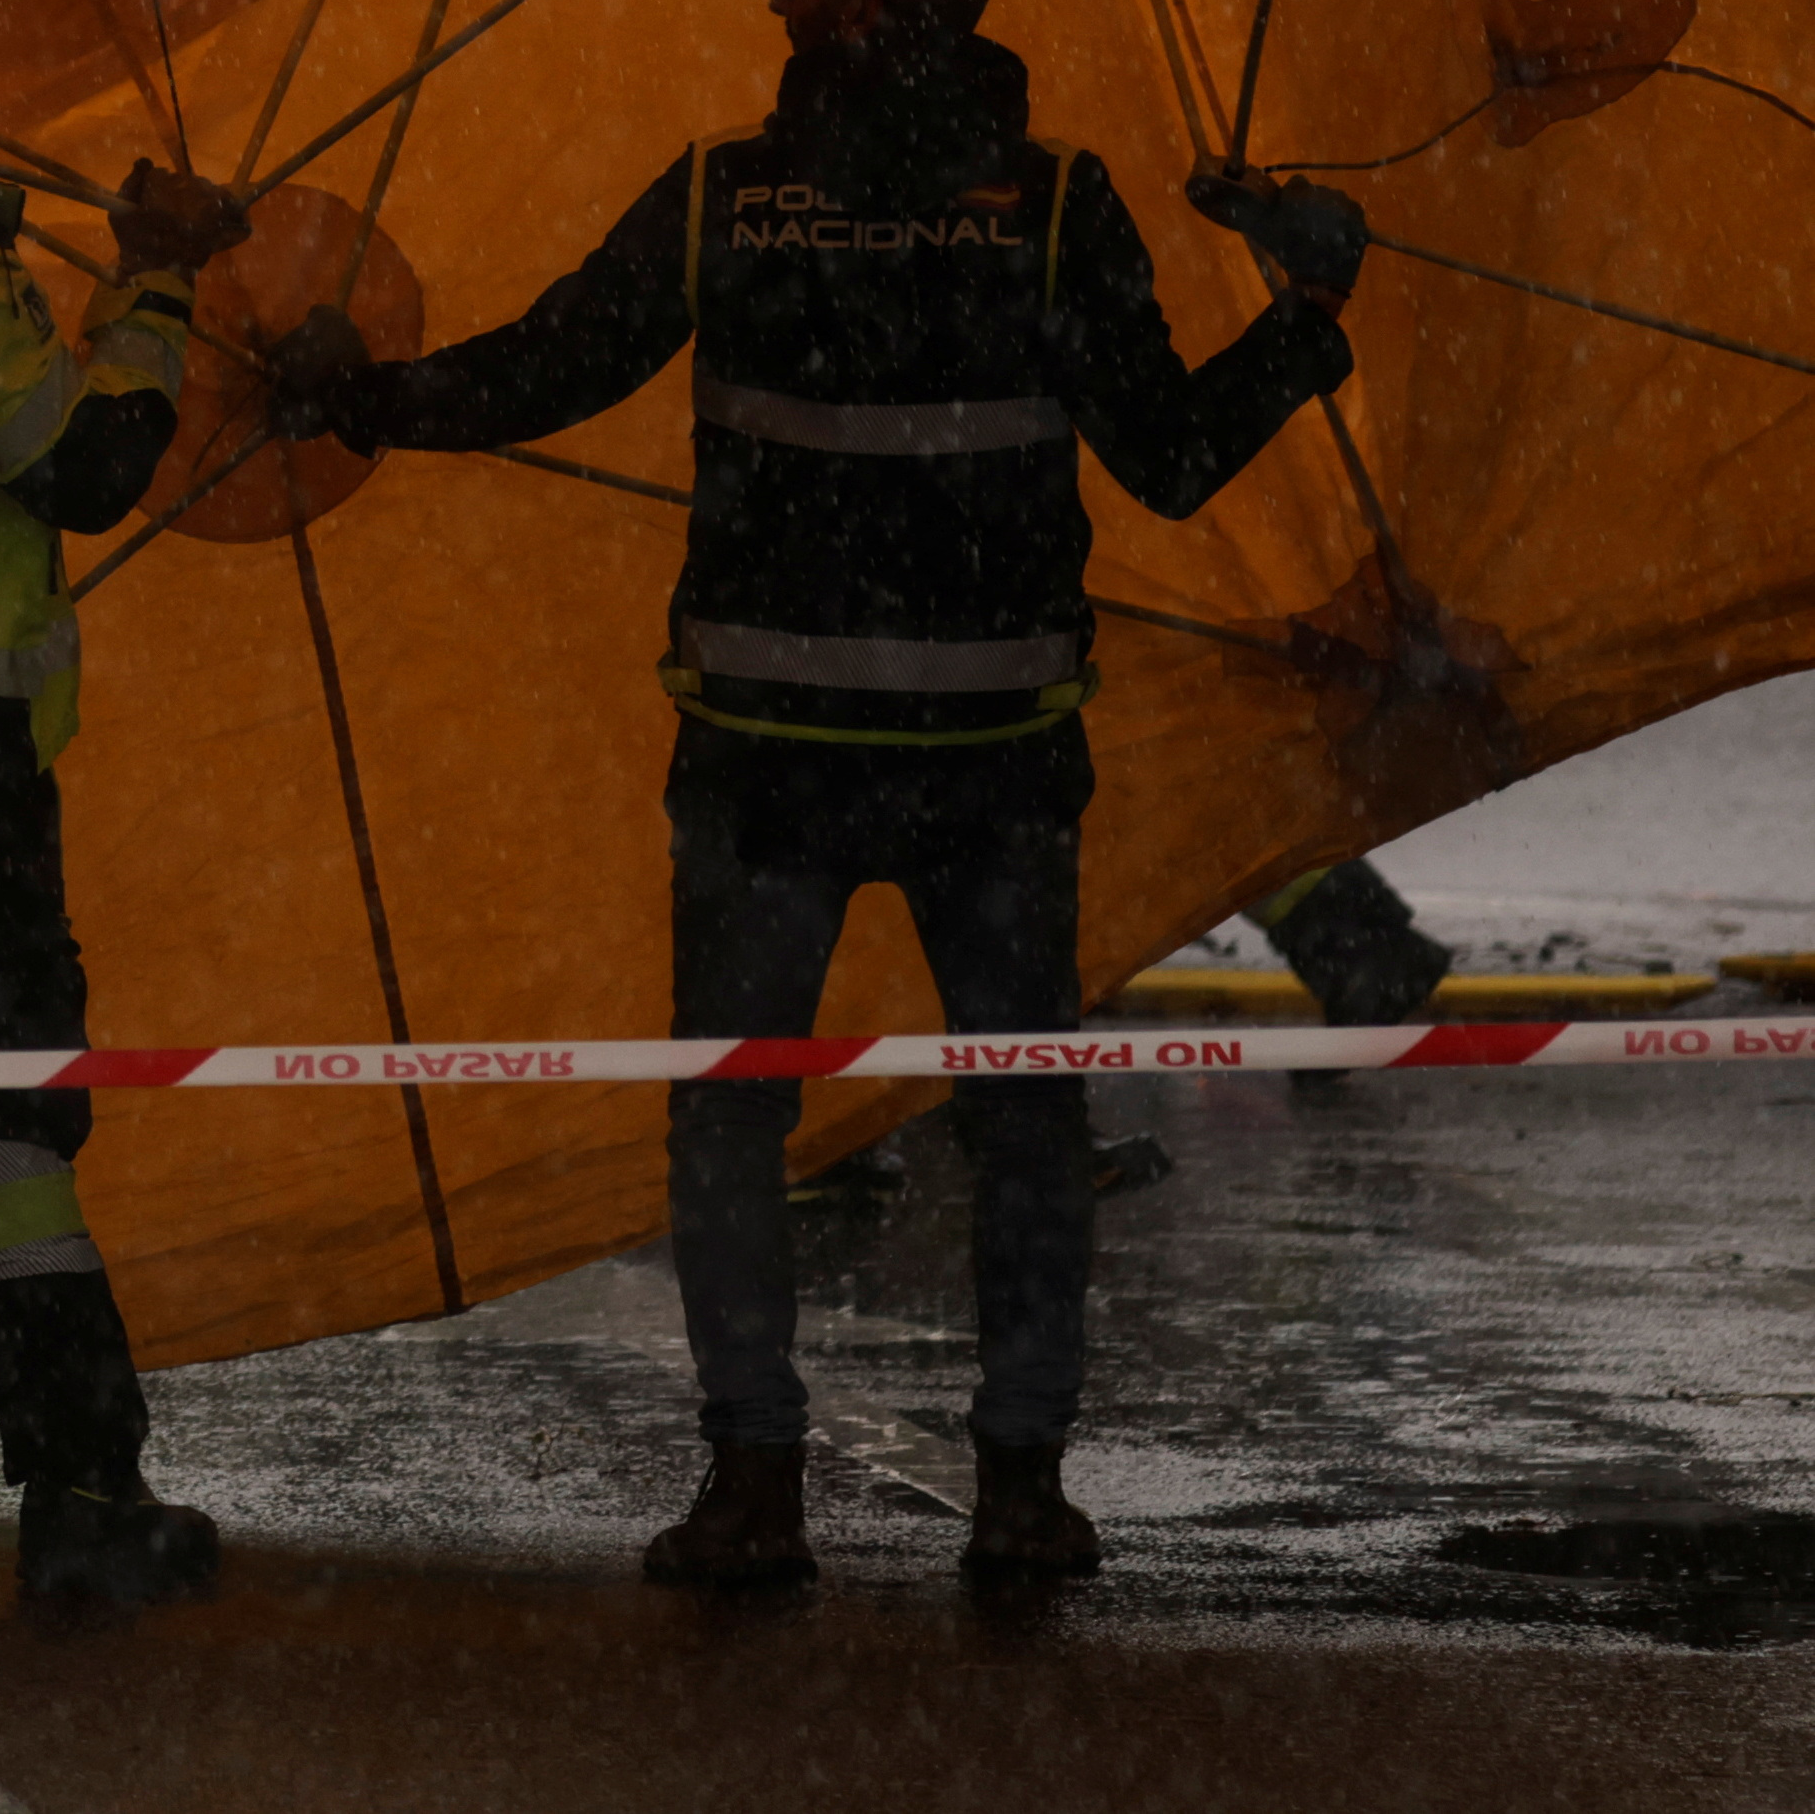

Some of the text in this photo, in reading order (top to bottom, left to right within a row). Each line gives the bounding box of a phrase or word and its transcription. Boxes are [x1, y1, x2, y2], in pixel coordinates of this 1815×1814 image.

[731, 215, 1024, 251] NACIONAL
[940, 1041, 1242, 1070] NO PASAR
